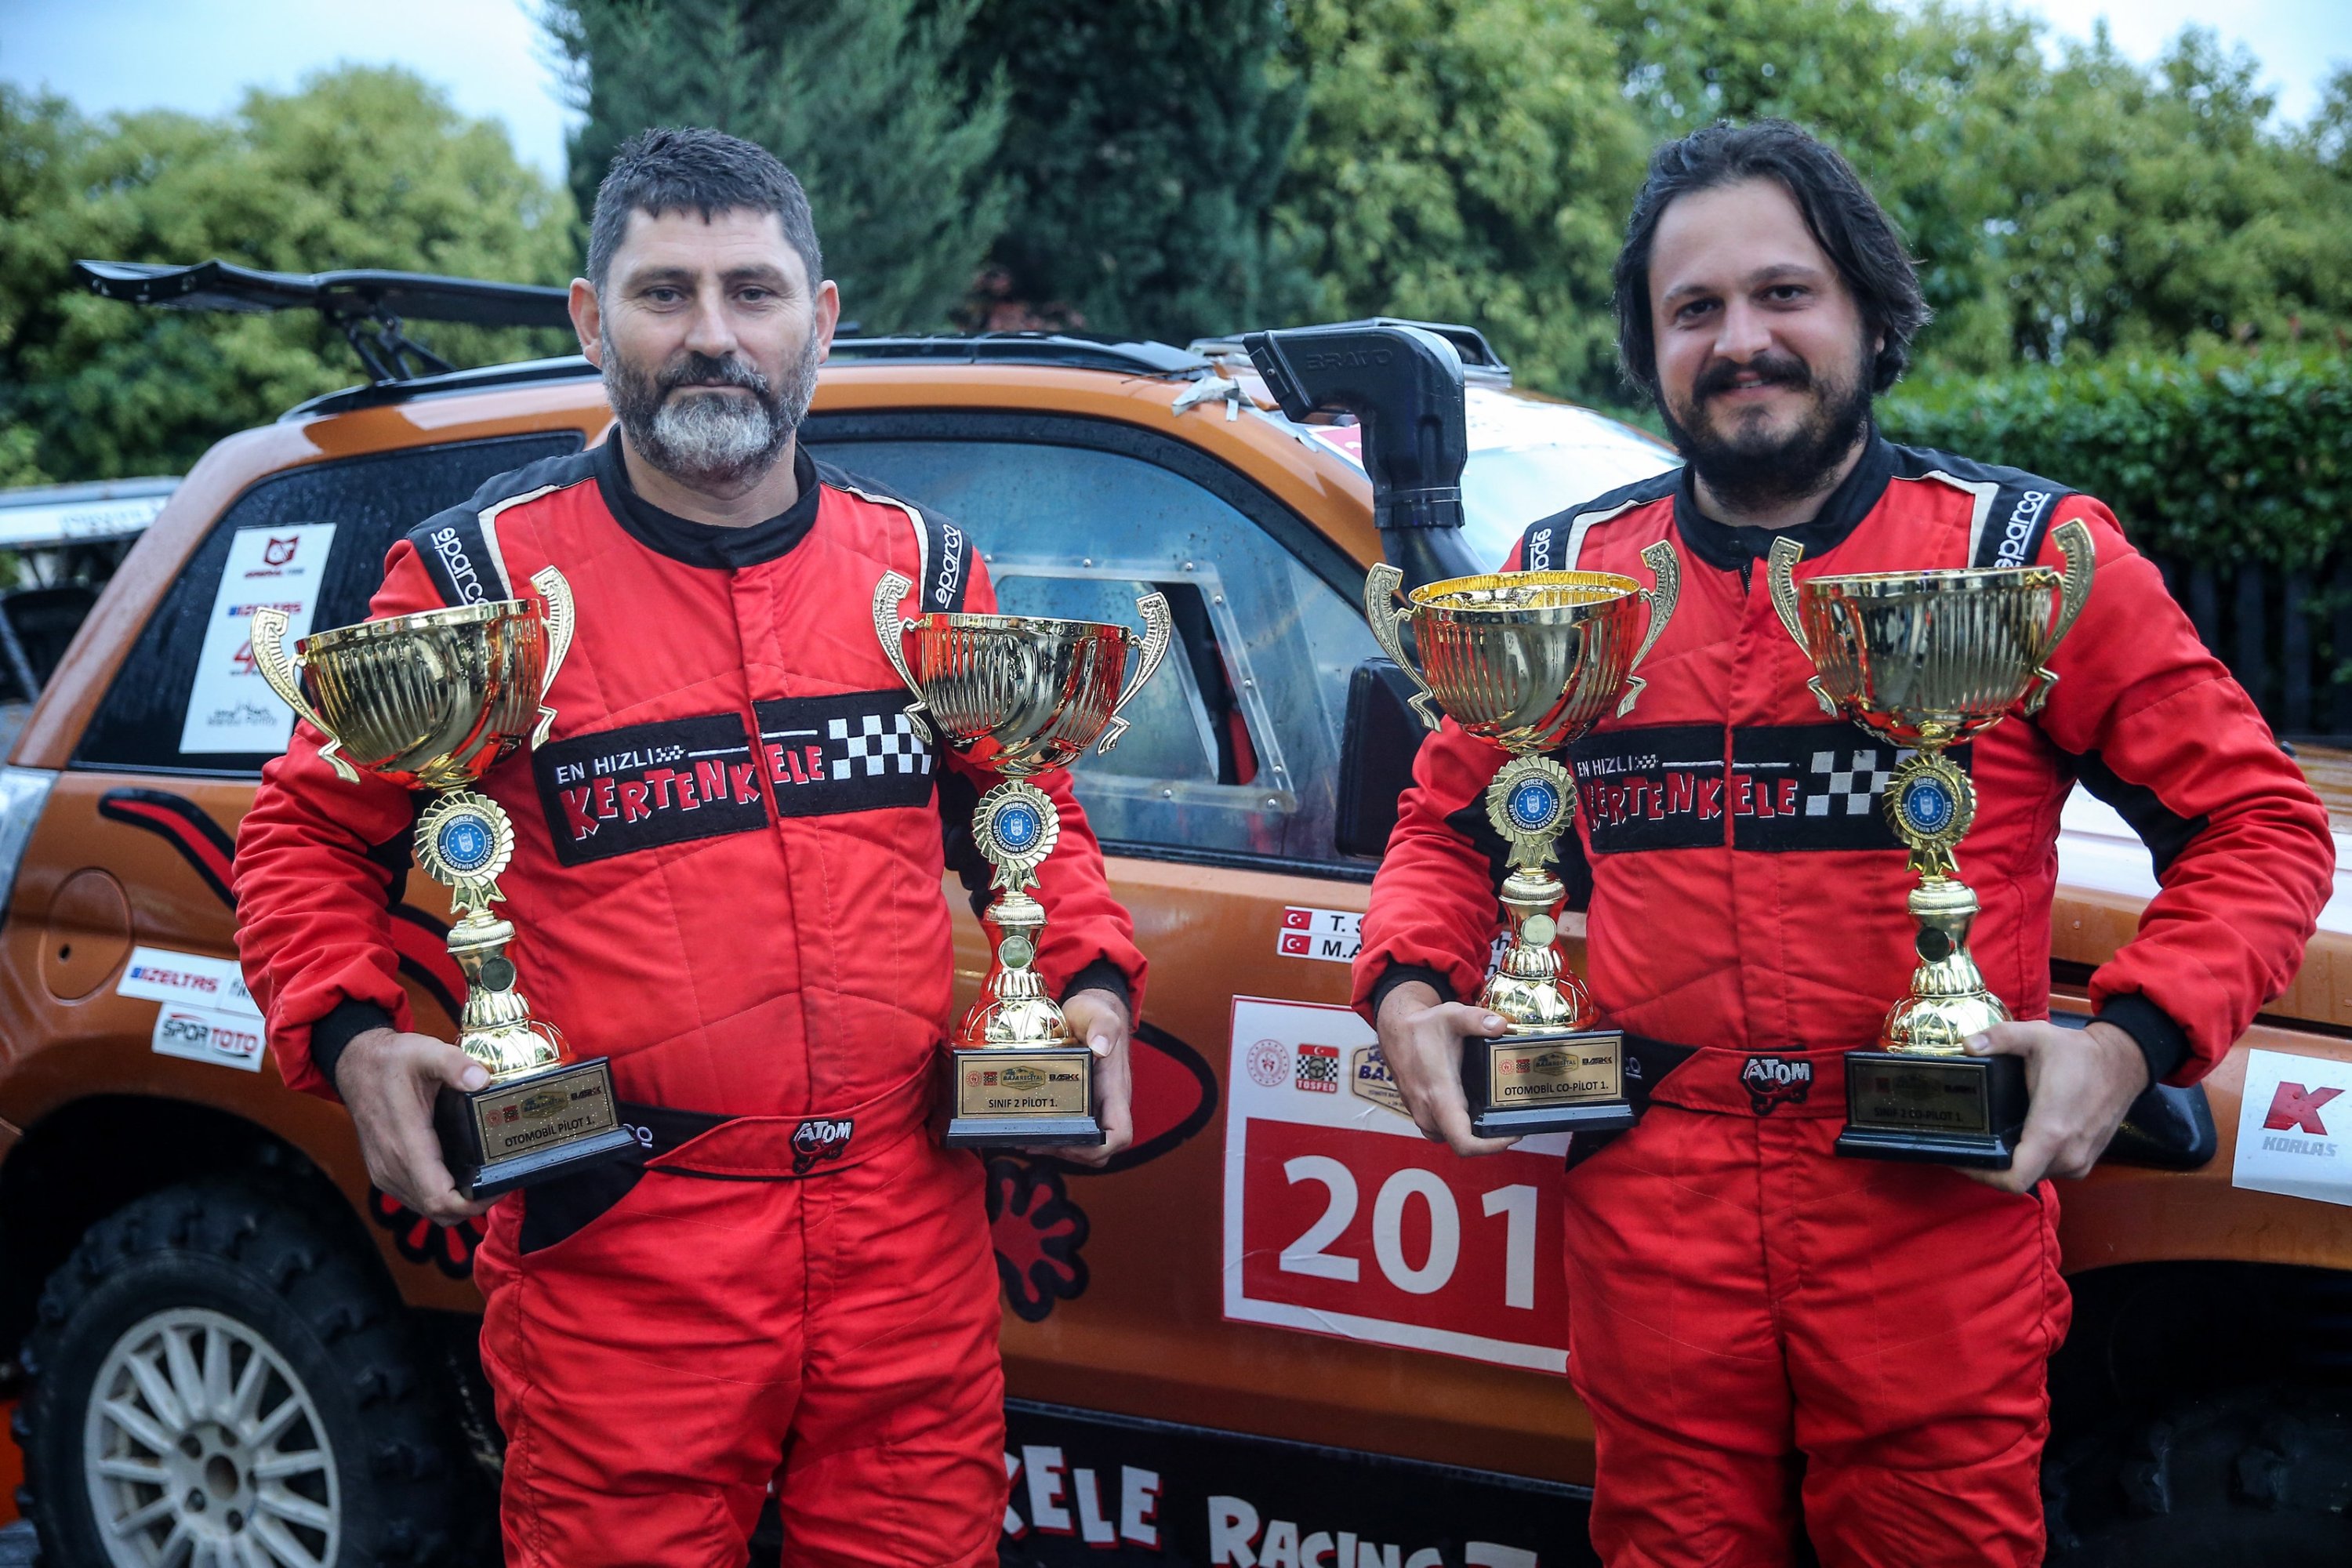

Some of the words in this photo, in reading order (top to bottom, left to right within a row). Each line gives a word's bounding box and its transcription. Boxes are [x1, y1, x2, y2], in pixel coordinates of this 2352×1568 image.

[431, 527, 489, 604] sparc
[935, 524, 962, 608] sparco
[556, 764, 586, 784] EN
[595, 749, 654, 775] HIZLI
[1577, 761, 1589, 777] EN
[1592, 755, 1632, 775] HIZLI
[560, 743, 826, 840] KERTENKELE
[1520, 779, 1544, 788] BURSA
[1914, 778, 1937, 786] BURSA
[1005, 802, 1028, 811] BURSA
[448, 815, 474, 827] BURSA
[1743, 1058, 1810, 1085] ATOM
[1297, 1080, 1337, 1092] TOSFED
[1504, 1083, 1555, 1096] OTOMOBİL
[1556, 1080, 1599, 1092] CO-PİLOT
[1601, 1081, 1609, 1090] 1.
[989, 1099, 1012, 1109] SINIF
[1014, 1099, 1020, 1108] 2
[1022, 1097, 1047, 1108] PİLOT
[1050, 1099, 1058, 1108] 1.
[505, 1124, 557, 1148] OTOMOBİL
[558, 1117, 583, 1135] PİLOT
[586, 1116, 595, 1126] 1.
[794, 1121, 852, 1143] ATOM
[2262, 1136, 2339, 1157] KORLAS
[1279, 1155, 1537, 1310] 201
